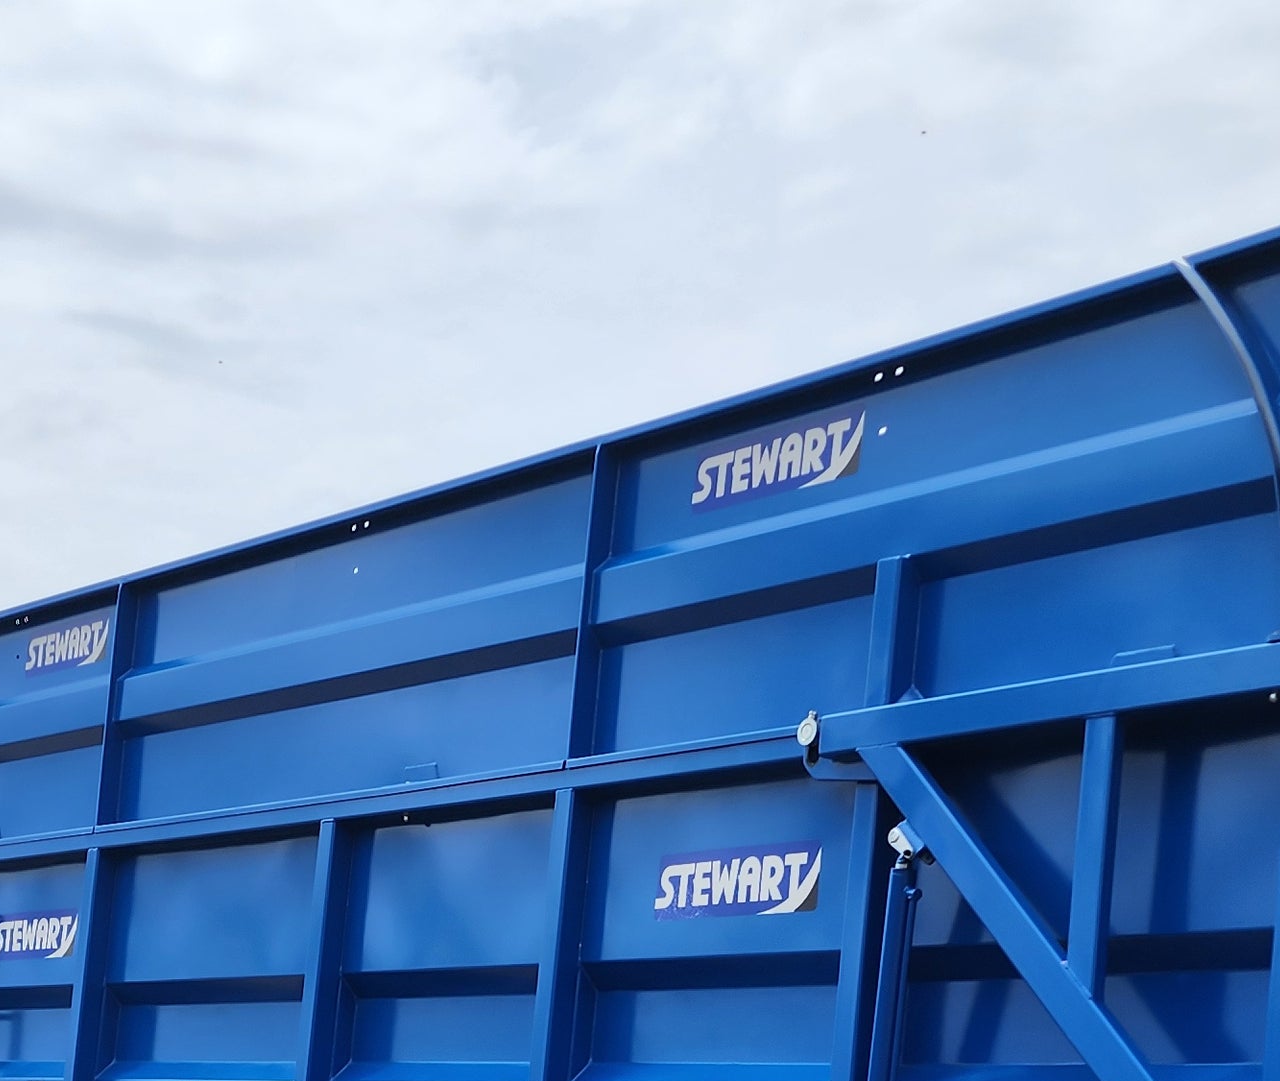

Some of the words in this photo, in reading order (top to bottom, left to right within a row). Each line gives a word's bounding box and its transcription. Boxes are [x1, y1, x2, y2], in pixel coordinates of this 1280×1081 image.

[692, 411, 865, 504] STEWART
[25, 618, 109, 670] STEWART
[654, 847, 822, 915] STEWART
